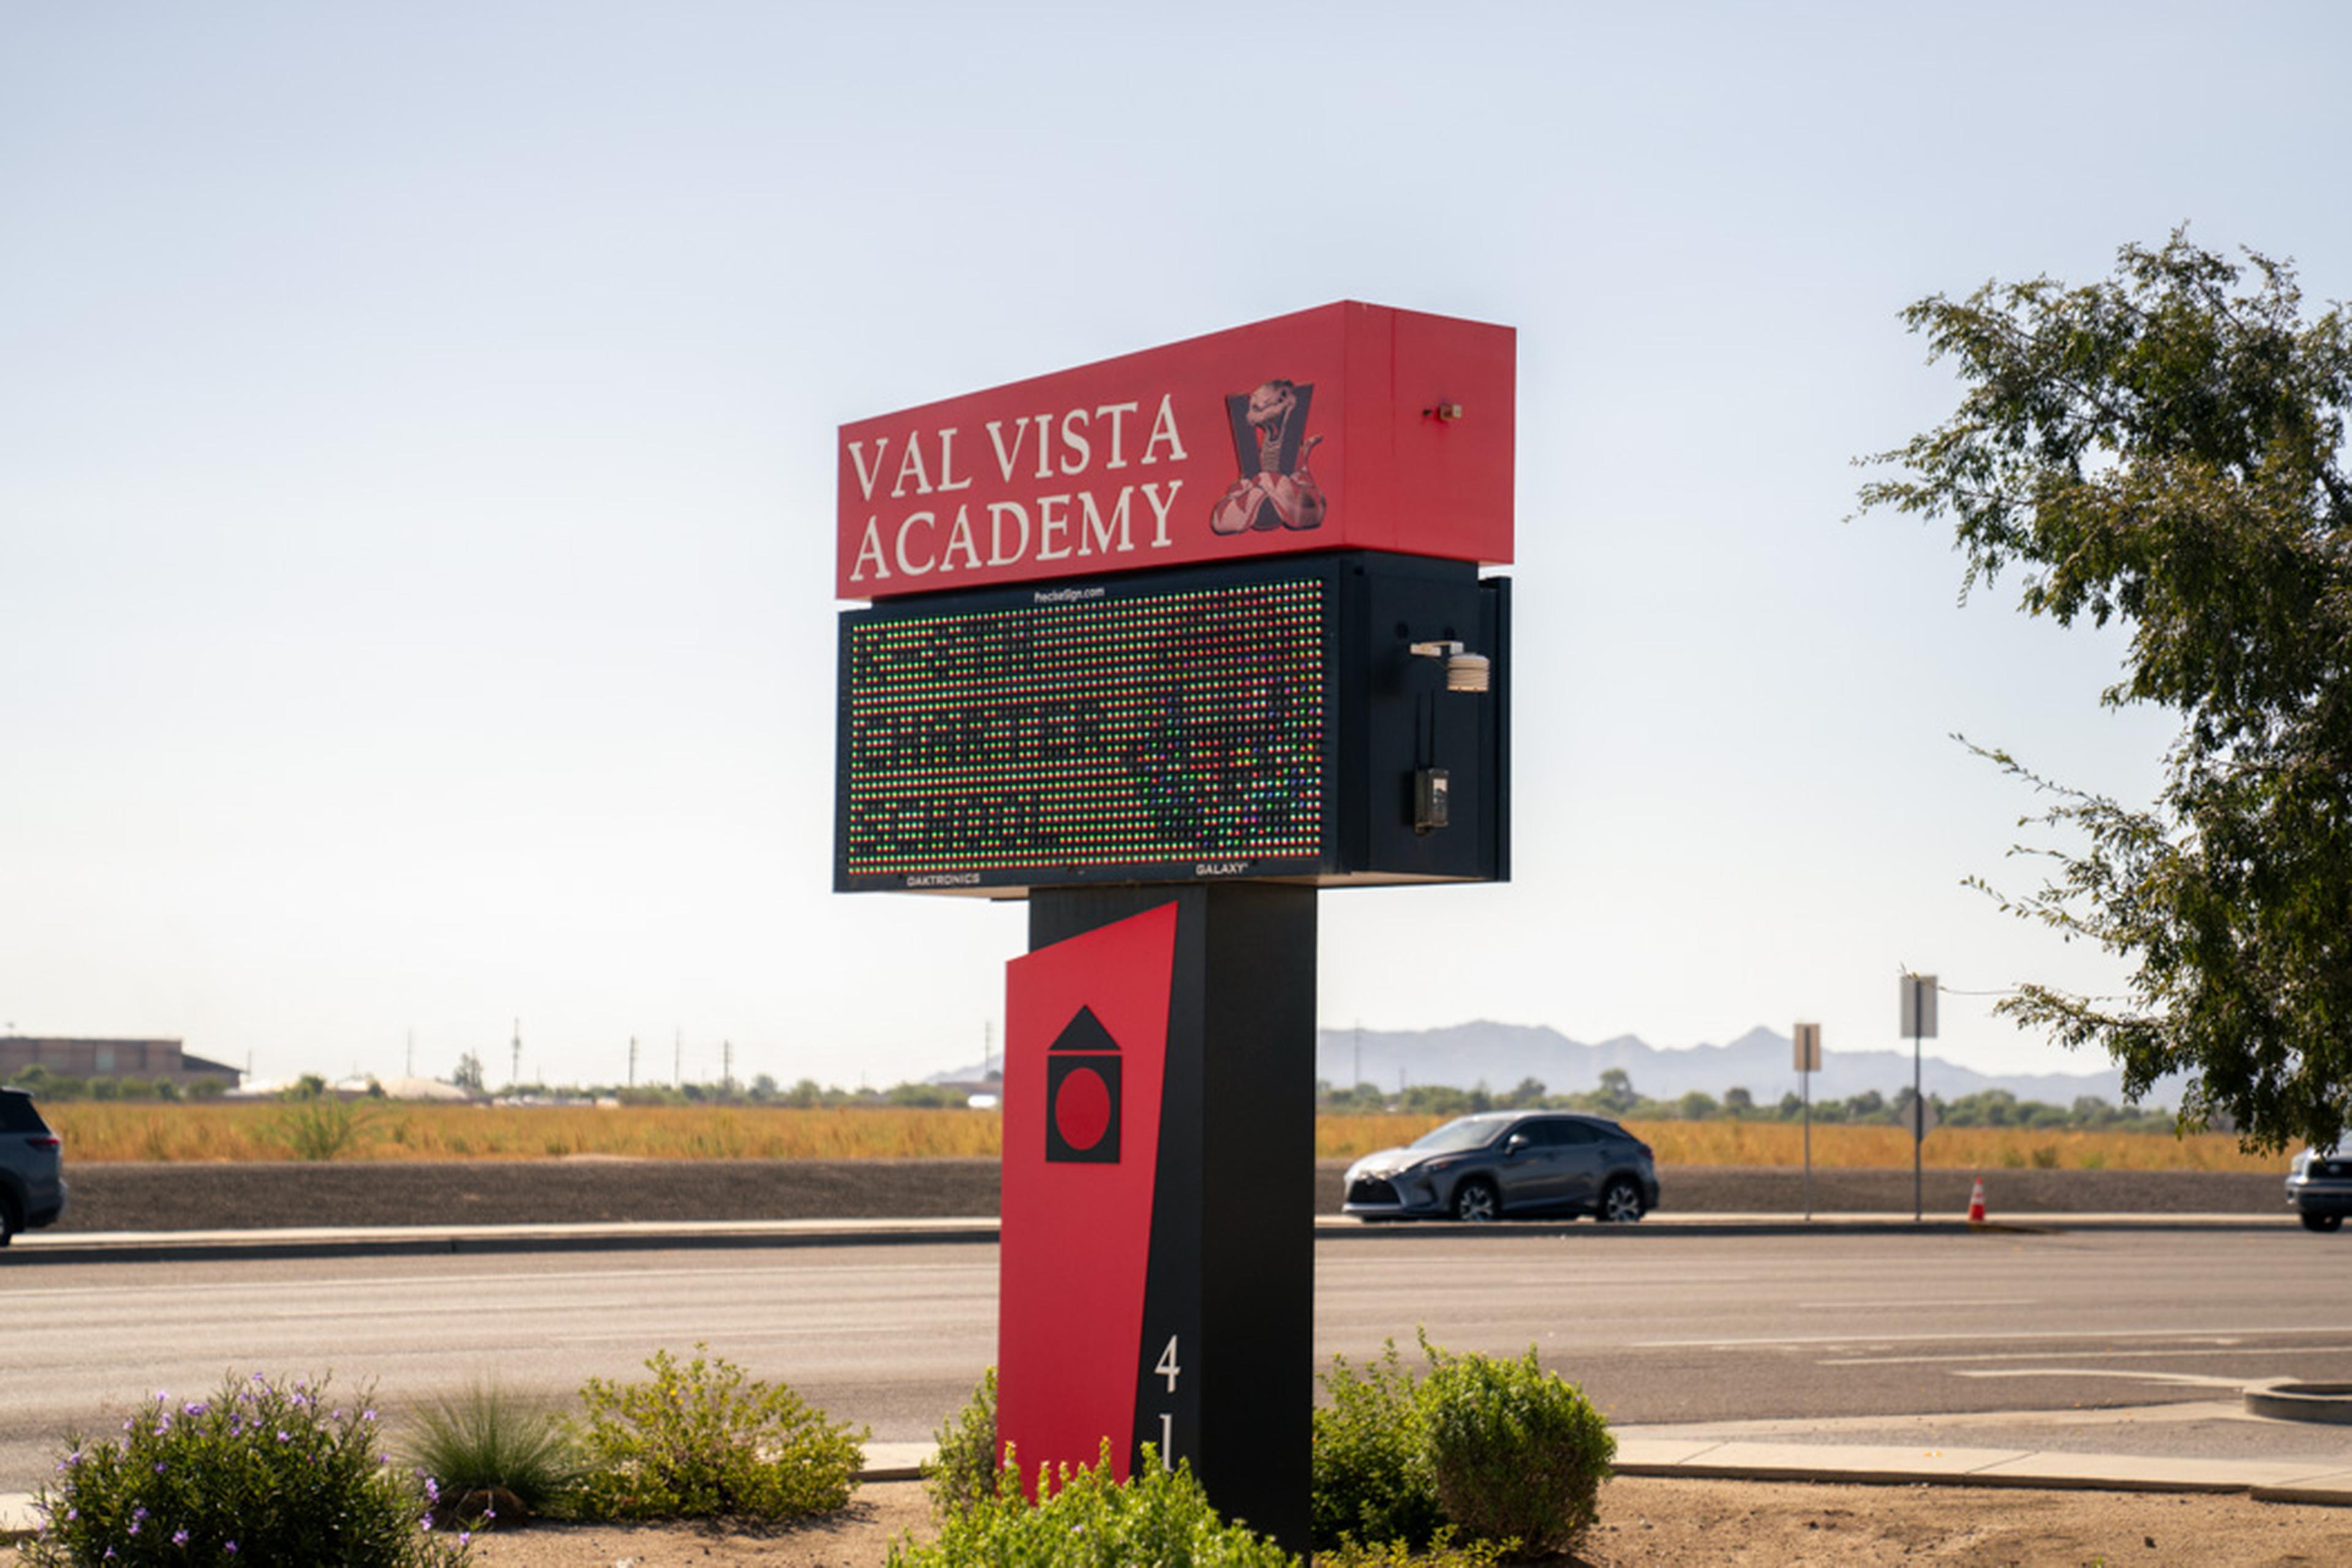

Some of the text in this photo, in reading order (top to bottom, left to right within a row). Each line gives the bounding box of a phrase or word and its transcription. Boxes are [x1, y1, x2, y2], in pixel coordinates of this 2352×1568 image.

[848, 394, 1187, 500] VAL VISTA
[850, 480, 1182, 581] ACADEMY
[856, 698, 1107, 772] CHARTER
[854, 790, 1061, 856] SCHOOL
